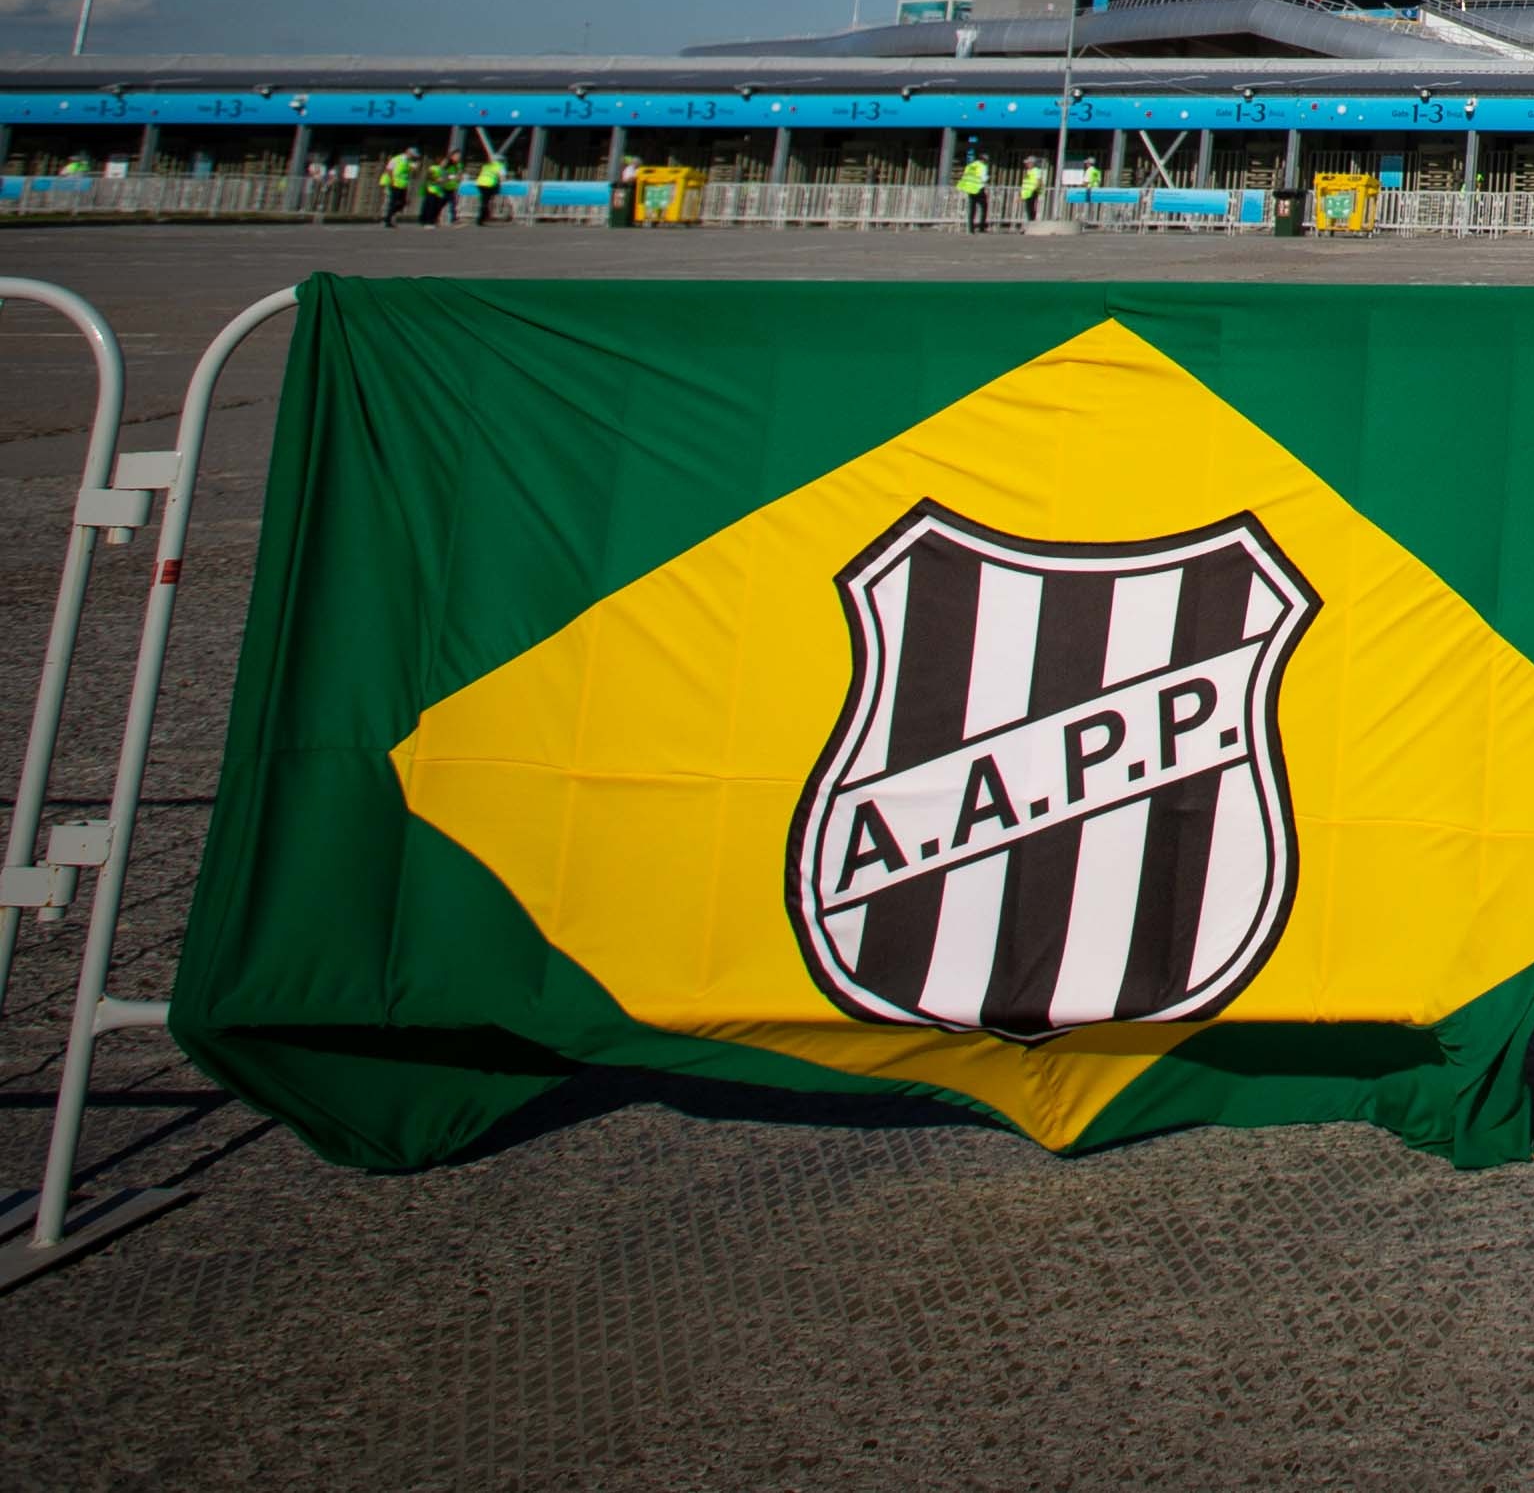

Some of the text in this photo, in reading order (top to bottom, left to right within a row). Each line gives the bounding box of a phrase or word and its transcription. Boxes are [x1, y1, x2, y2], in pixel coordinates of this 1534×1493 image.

[851, 101, 881, 121] 1-3
[1235, 102, 1266, 122] 1-3
[1412, 103, 1444, 123] 1-3
[834, 677, 1240, 896] A.A.P.P.
